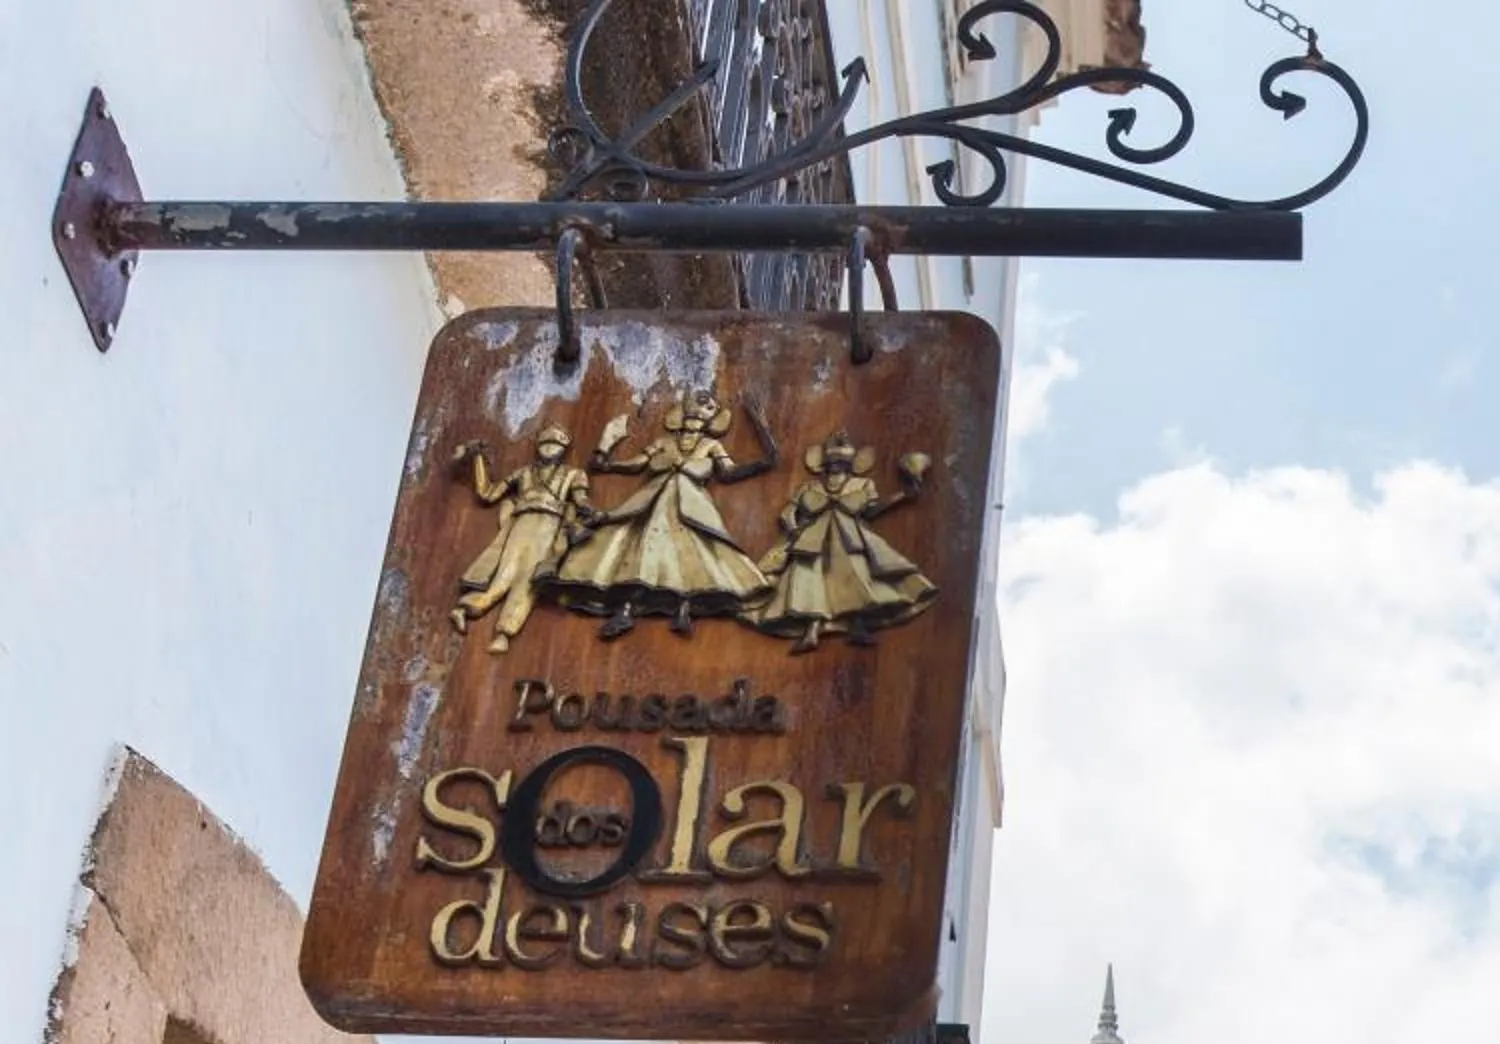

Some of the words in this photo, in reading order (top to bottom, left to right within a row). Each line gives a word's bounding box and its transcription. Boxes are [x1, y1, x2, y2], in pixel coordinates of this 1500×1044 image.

[508, 679, 785, 733] Pousada
[534, 802, 628, 846] dos
[430, 869, 835, 970] deuses
